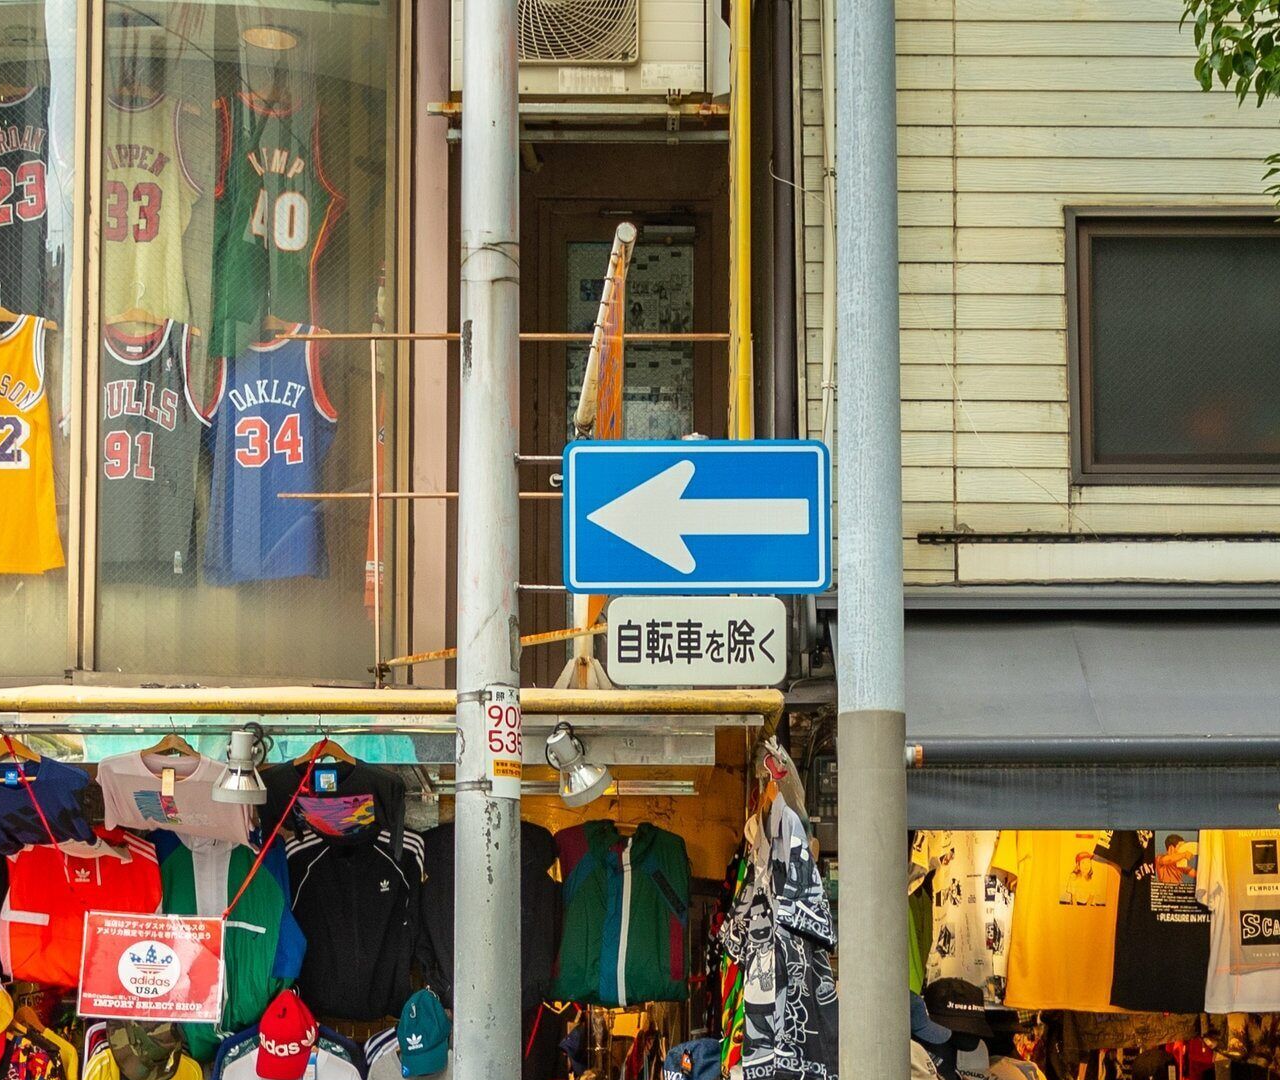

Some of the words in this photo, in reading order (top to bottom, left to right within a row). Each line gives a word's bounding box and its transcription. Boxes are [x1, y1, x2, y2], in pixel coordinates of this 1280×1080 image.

[105, 180, 162, 243] 33
[252, 188, 310, 251] 40
[228, 379, 306, 412] OAKLEY
[104, 430, 156, 481] 91
[234, 413, 304, 468] 34
[618, 619, 776, 665] 自転車を除く
[130, 976, 170, 987] adidas
[136, 986, 158, 995] USA
[93, 998, 134, 1009] IMPORT
[135, 1000, 174, 1010] SELECT
[176, 1001, 202, 1011] SHOP
[746, 1065, 773, 1080] HOP
